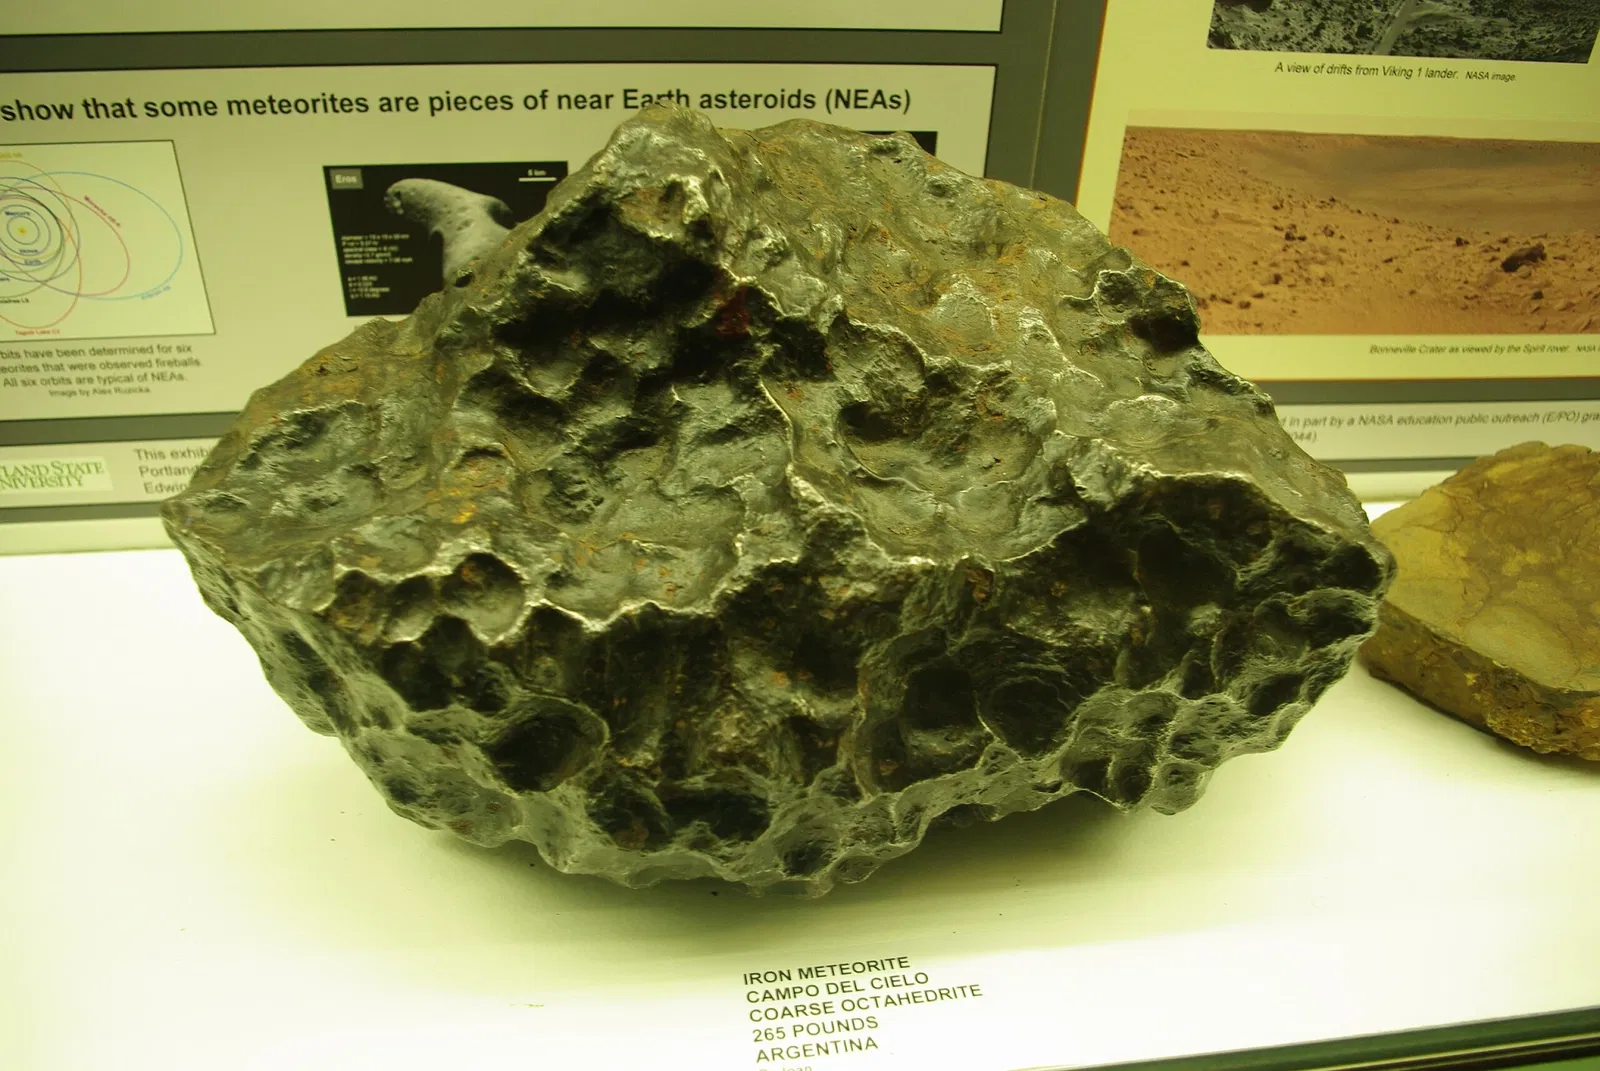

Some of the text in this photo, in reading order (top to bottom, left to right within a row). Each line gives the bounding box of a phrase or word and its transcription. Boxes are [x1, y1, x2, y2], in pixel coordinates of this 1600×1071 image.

[1275, 61, 1459, 79] A view of drifts from Viking 1 lander.
[1465, 71, 1489, 80] NASA
[1, 98, 74, 121] show
[82, 98, 138, 120] that
[144, 99, 218, 118] some
[227, 92, 370, 116] meteorites
[378, 96, 419, 113] are
[428, 90, 514, 116] pieces
[522, 89, 549, 110] of
[556, 92, 614, 110] near
[699, 88, 816, 110] asteroids
[825, 88, 912, 114] (NEAs)
[335, 174, 357, 184] Eros
[24, 349, 53, 359] have
[56, 348, 86, 358] been
[88, 345, 154, 356] determined
[157, 344, 172, 354] for
[176, 344, 192, 353] six
[1370, 344, 1417, 354] Bonneville
[1419, 344, 1447, 354] Crater
[1462, 344, 1493, 353] viewed
[1494, 344, 1506, 356] by
[1507, 344, 1521, 353] the
[1523, 343, 1547, 355] Spirit
[42, 362, 65, 372] that
[68, 362, 96, 371] were
[99, 360, 153, 370] observed
[3, 377, 19, 387] All
[21, 378, 37, 387] six
[40, 377, 73, 386] orbits
[75, 376, 94, 385] are
[96, 374, 134, 386] typical
[137, 372, 148, 382] of
[48, 389, 77, 398] Image
[78, 388, 90, 397] by
[1289, 415, 1300, 426] in
[1302, 415, 1327, 428] part
[1329, 415, 1344, 428] by
[1347, 417, 1355, 426] a
[1358, 414, 1394, 426] NASA
[1397, 413, 1453, 426] education
[1455, 412, 1489, 428] public
[1491, 411, 1540, 424] outreach
[133, 446, 210, 460] This exhib
[50, 460, 104, 475] STATE
[743, 955, 911, 986] IRON METEORITE
[746, 972, 930, 1004] CAMPO DEL CIELO
[749, 984, 983, 1023] COARSE OCTAHEDRITE
[752, 1015, 879, 1043] 265 POUNDS
[756, 1036, 879, 1063] ARGENTINA
